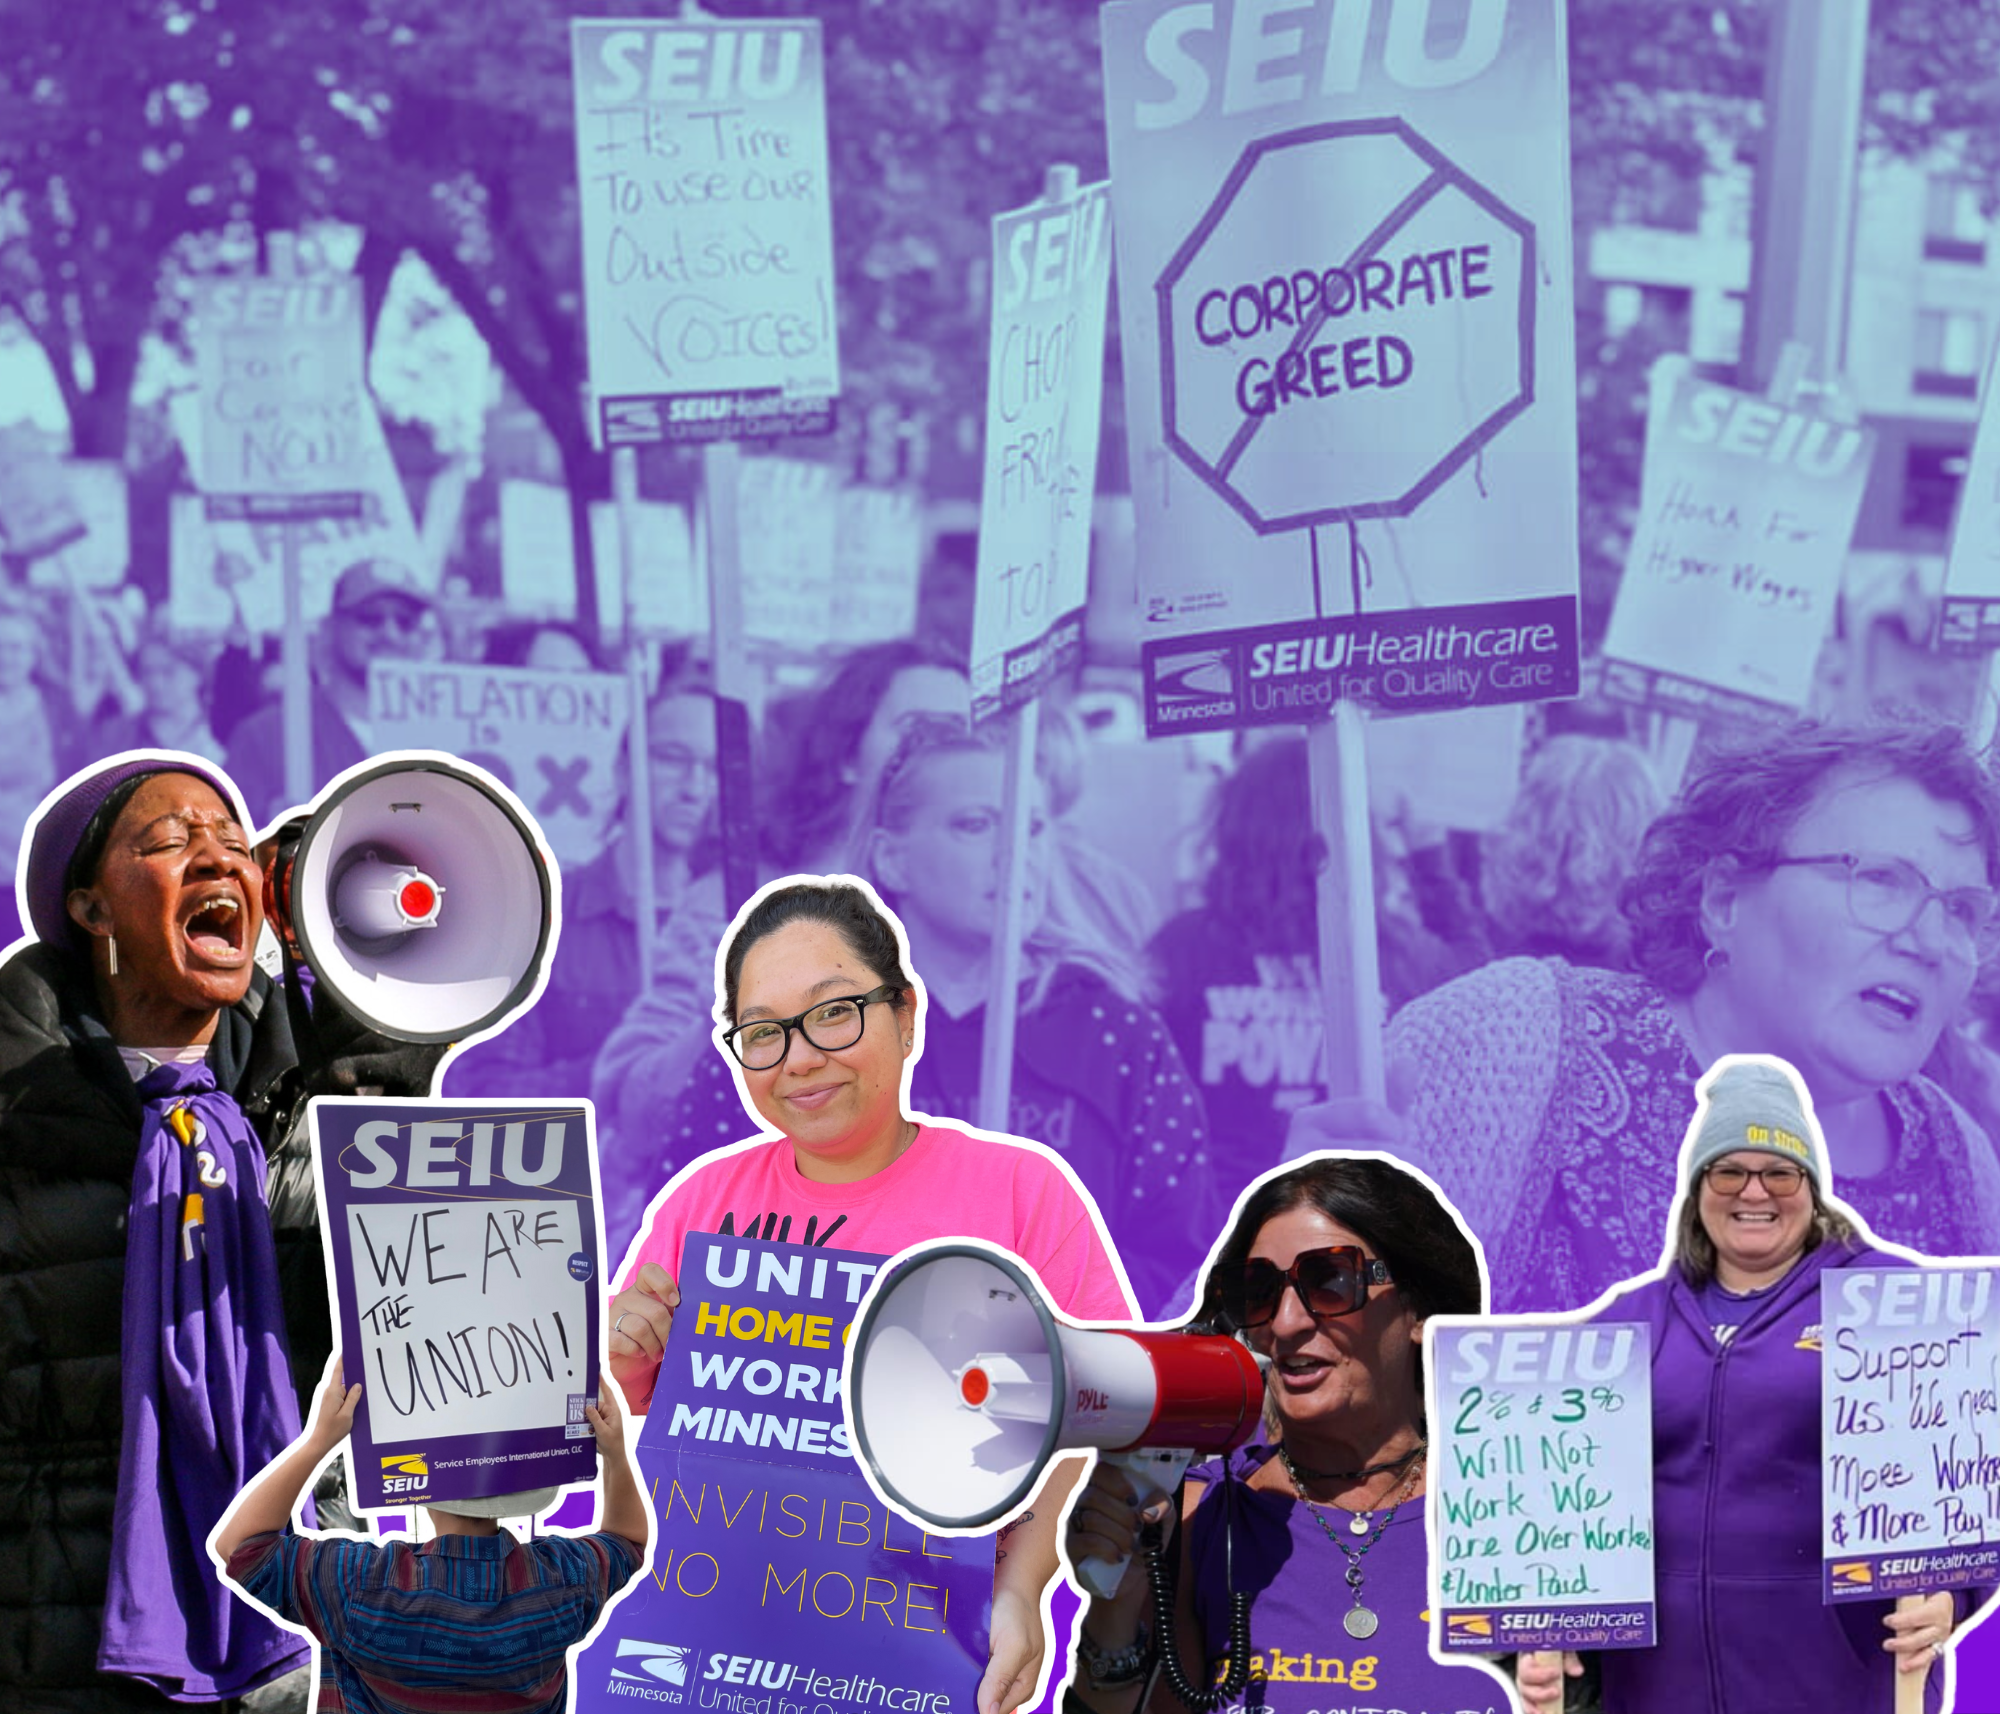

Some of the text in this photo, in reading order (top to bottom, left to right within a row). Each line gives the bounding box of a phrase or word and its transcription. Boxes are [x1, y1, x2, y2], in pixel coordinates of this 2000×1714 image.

[595, 31, 802, 99] SEIU
[1134, 0, 1506, 130] SEIU
[1003, 196, 1106, 312] SEIU
[212, 283, 345, 327] SEIU
[1195, 245, 1493, 346] CORPORATE
[1236, 336, 1413, 416] GREED
[1677, 388, 1862, 478] SEIU
[376, 672, 612, 729] INFLATION
[1157, 700, 1236, 722] Minnesota
[1251, 658, 1553, 711] United for Quality Care
[350, 1120, 566, 1189] SEIU
[355, 1208, 564, 1295] WE ARE
[361, 1294, 415, 1336] THE
[694, 1301, 834, 1350] HOME
[1837, 1271, 1993, 1327] SEIU
[376, 1311, 574, 1416] UNION!
[1453, 1330, 1634, 1384] SEIU
[1833, 1314, 1982, 1403] Support
[569, 1409, 584, 1421] US
[1910, 1379, 1948, 1430] We
[434, 1459, 464, 1469] Service
[465, 1454, 508, 1466] Employees
[508, 1451, 550, 1461] International
[571, 1444, 583, 1453] CLC
[1453, 1430, 1602, 1479] Will Not
[382, 1475, 429, 1494] SEIU
[1443, 1473, 1612, 1529] Work We
[762, 1562, 949, 1634] MORE!
[1525, 1562, 1600, 1597] Paid
[1972, 1566, 1996, 1580] Care
[1501, 1627, 1643, 1645] United for Quality Care
[607, 1680, 683, 1705] Minnesota
